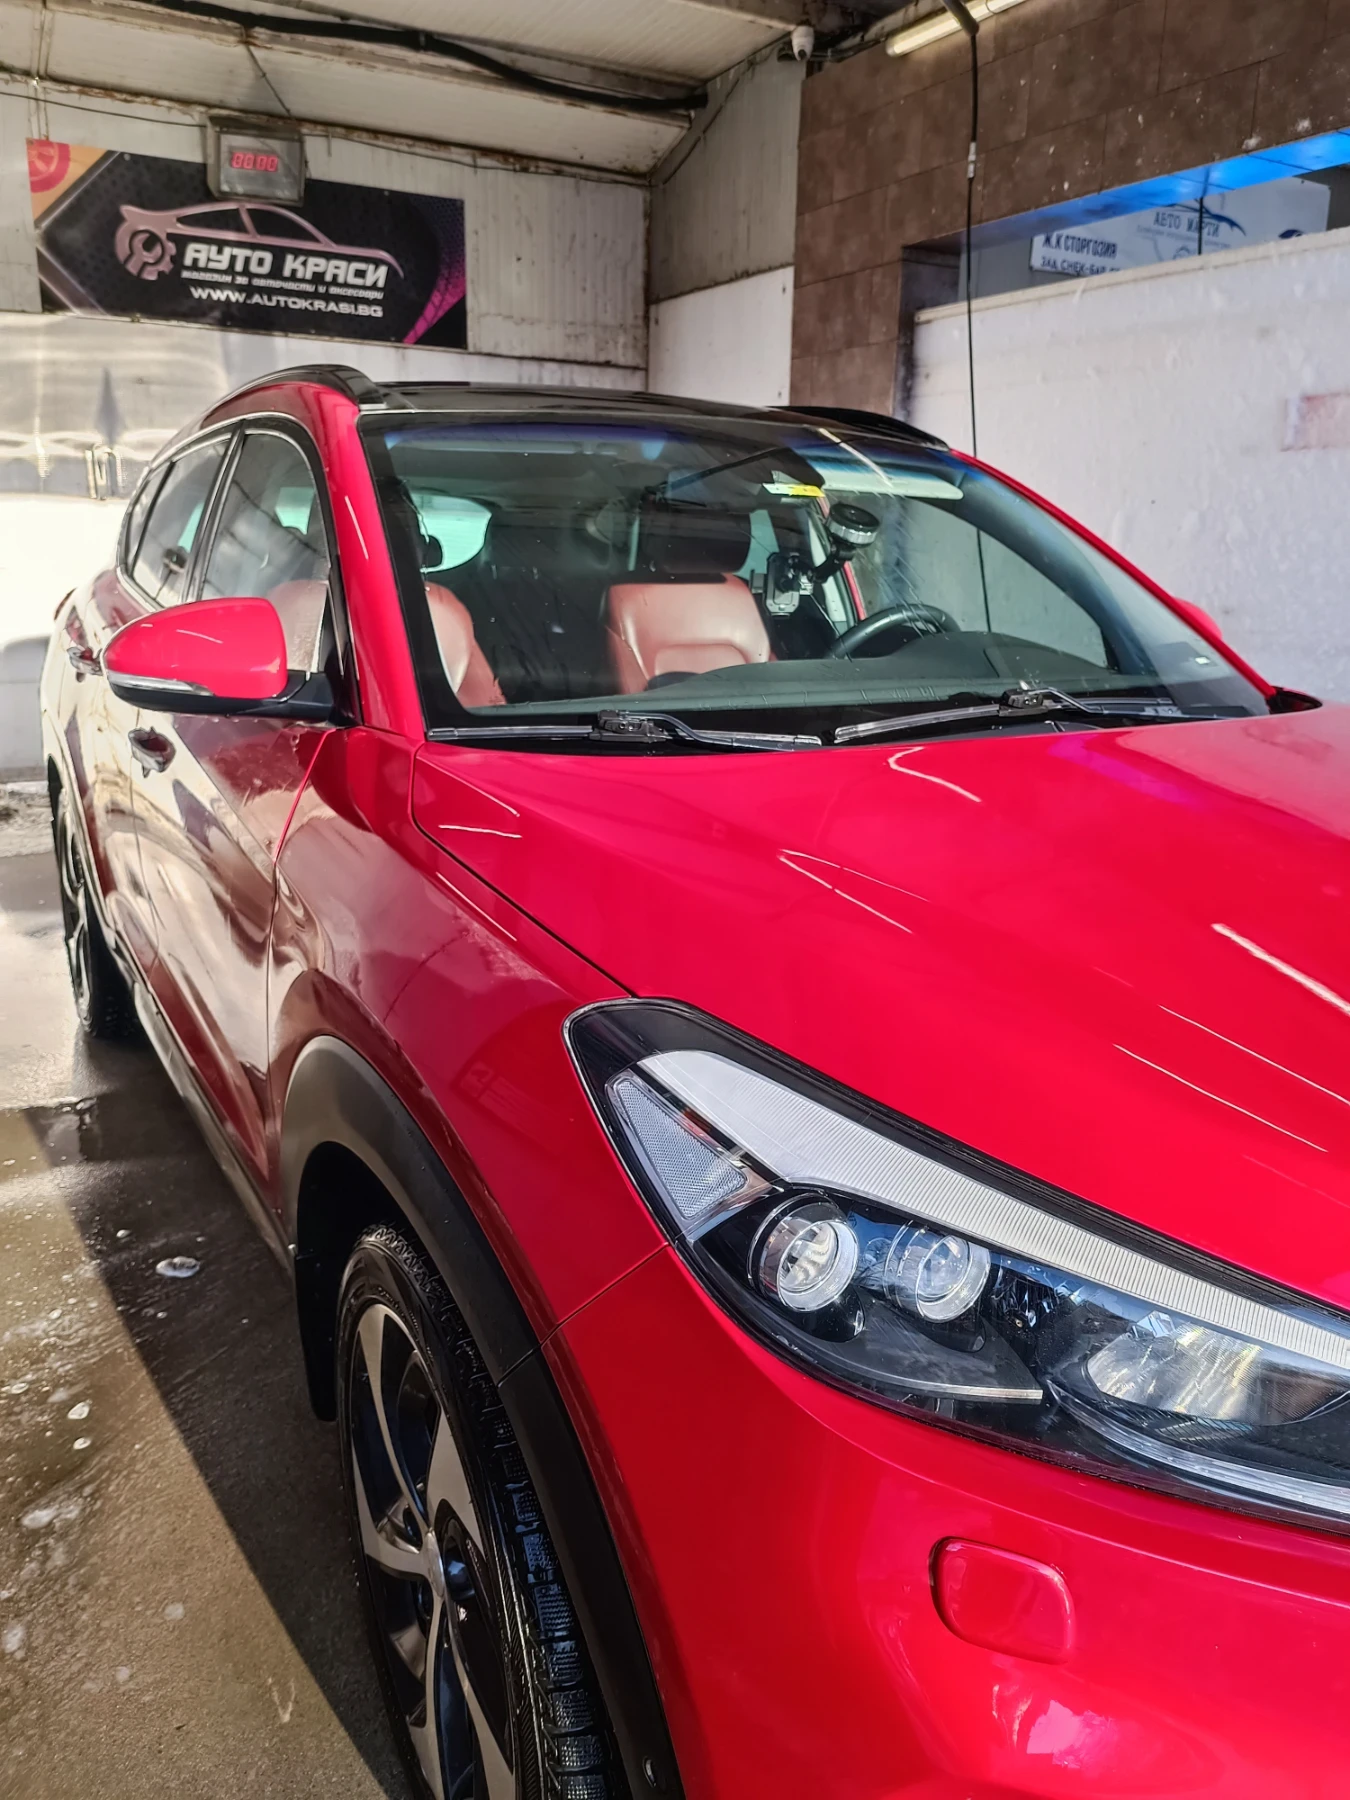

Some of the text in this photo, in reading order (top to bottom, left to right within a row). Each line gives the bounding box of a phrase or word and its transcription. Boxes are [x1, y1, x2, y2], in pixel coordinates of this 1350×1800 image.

[1064, 234, 1117, 259] СТОРГОЗИЯ
[183, 243, 389, 289] АУТО КРАСИ
[189, 285, 384, 318] WWW.AUTOKRASI.BG
